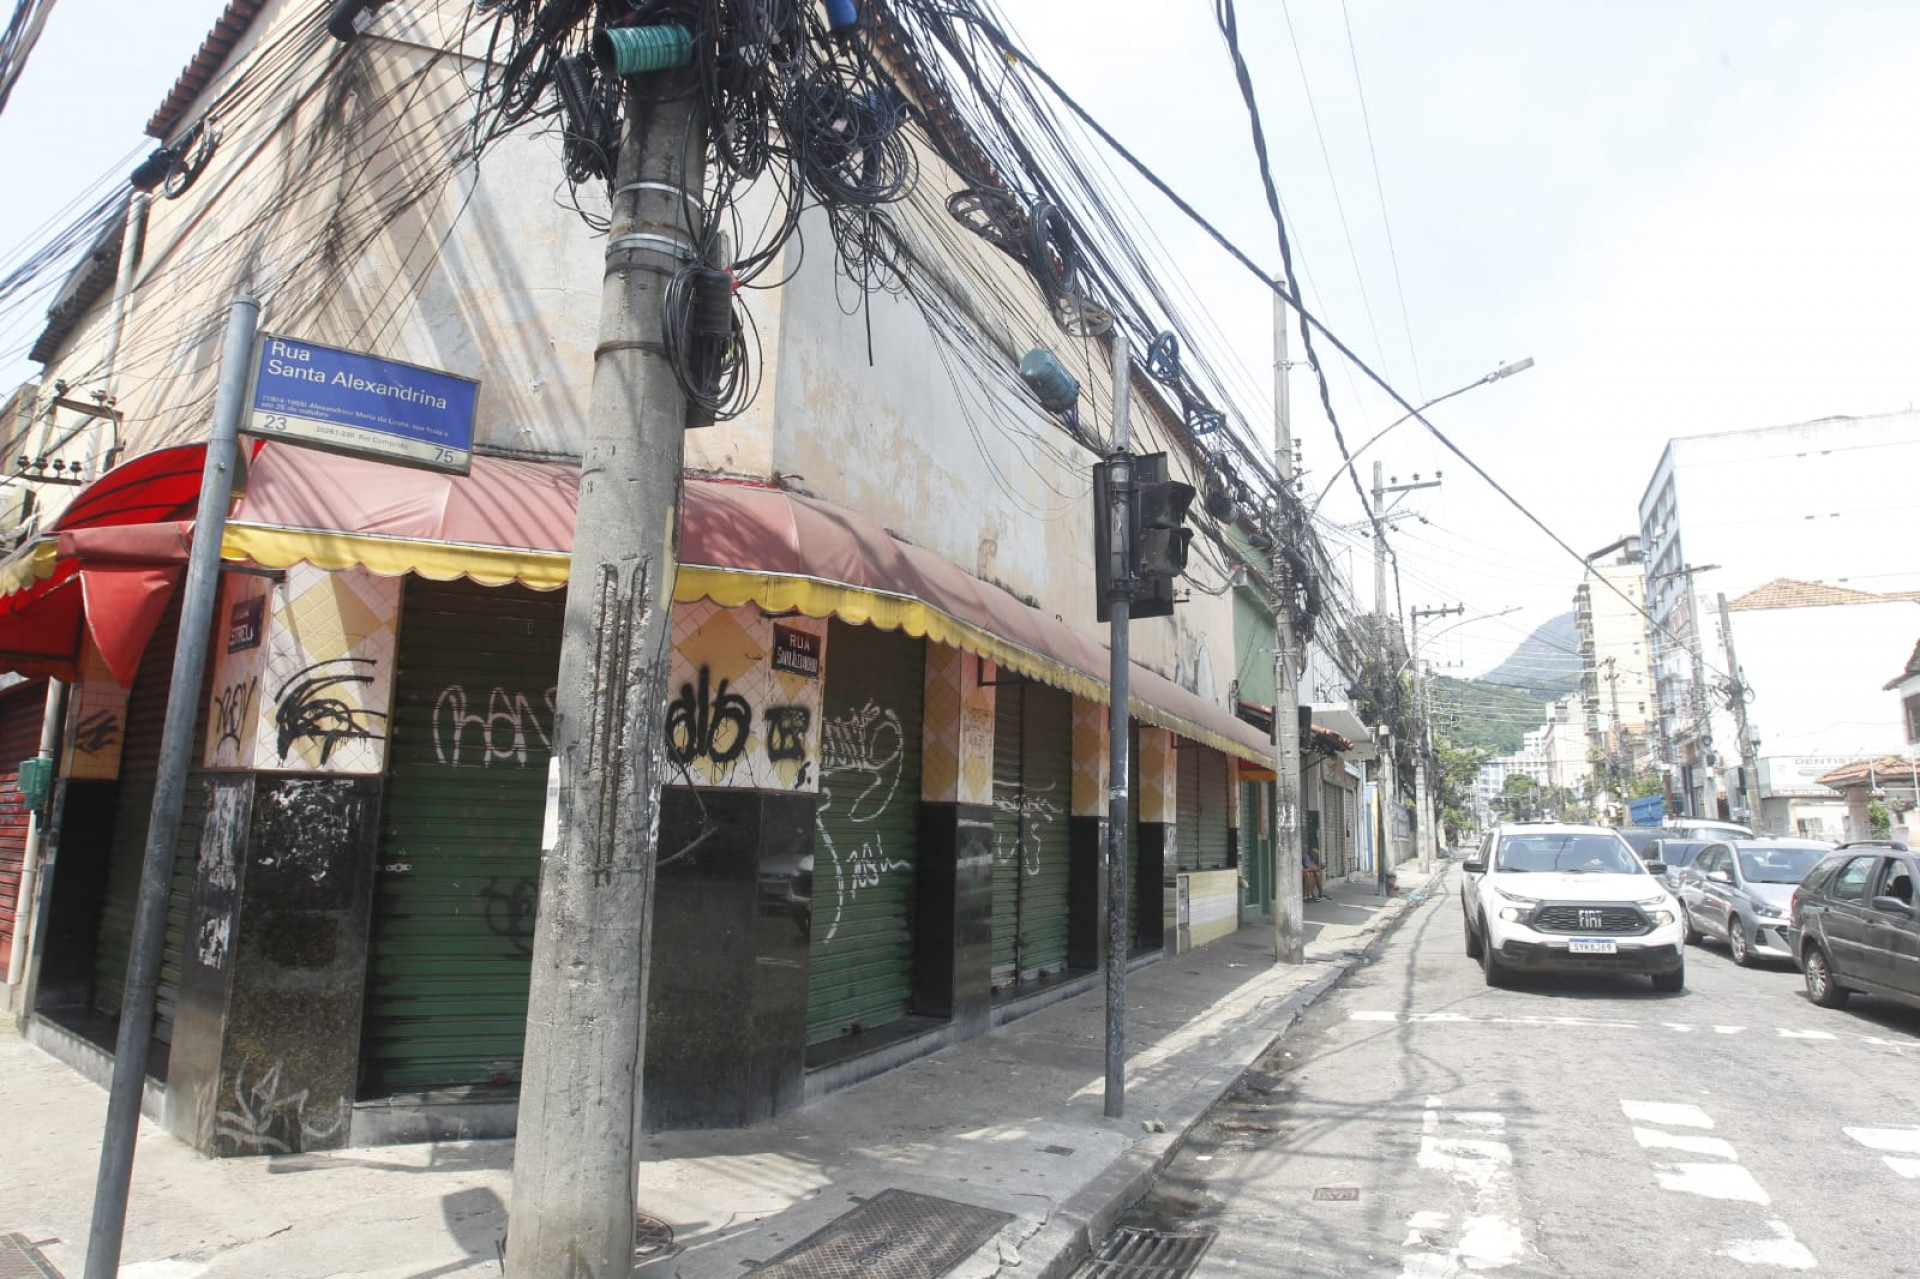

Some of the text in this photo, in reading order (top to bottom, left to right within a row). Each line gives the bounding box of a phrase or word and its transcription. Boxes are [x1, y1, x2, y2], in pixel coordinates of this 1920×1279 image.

[271, 341, 311, 361] Rua
[268, 359, 448, 410] Santa Alexandrina
[263, 415, 287, 432] 23
[435, 448, 454, 465] 75
[789, 633, 811, 651] RUA
[1795, 757, 1862, 766] DENTIST
[1578, 909, 1603, 928] FIAT
